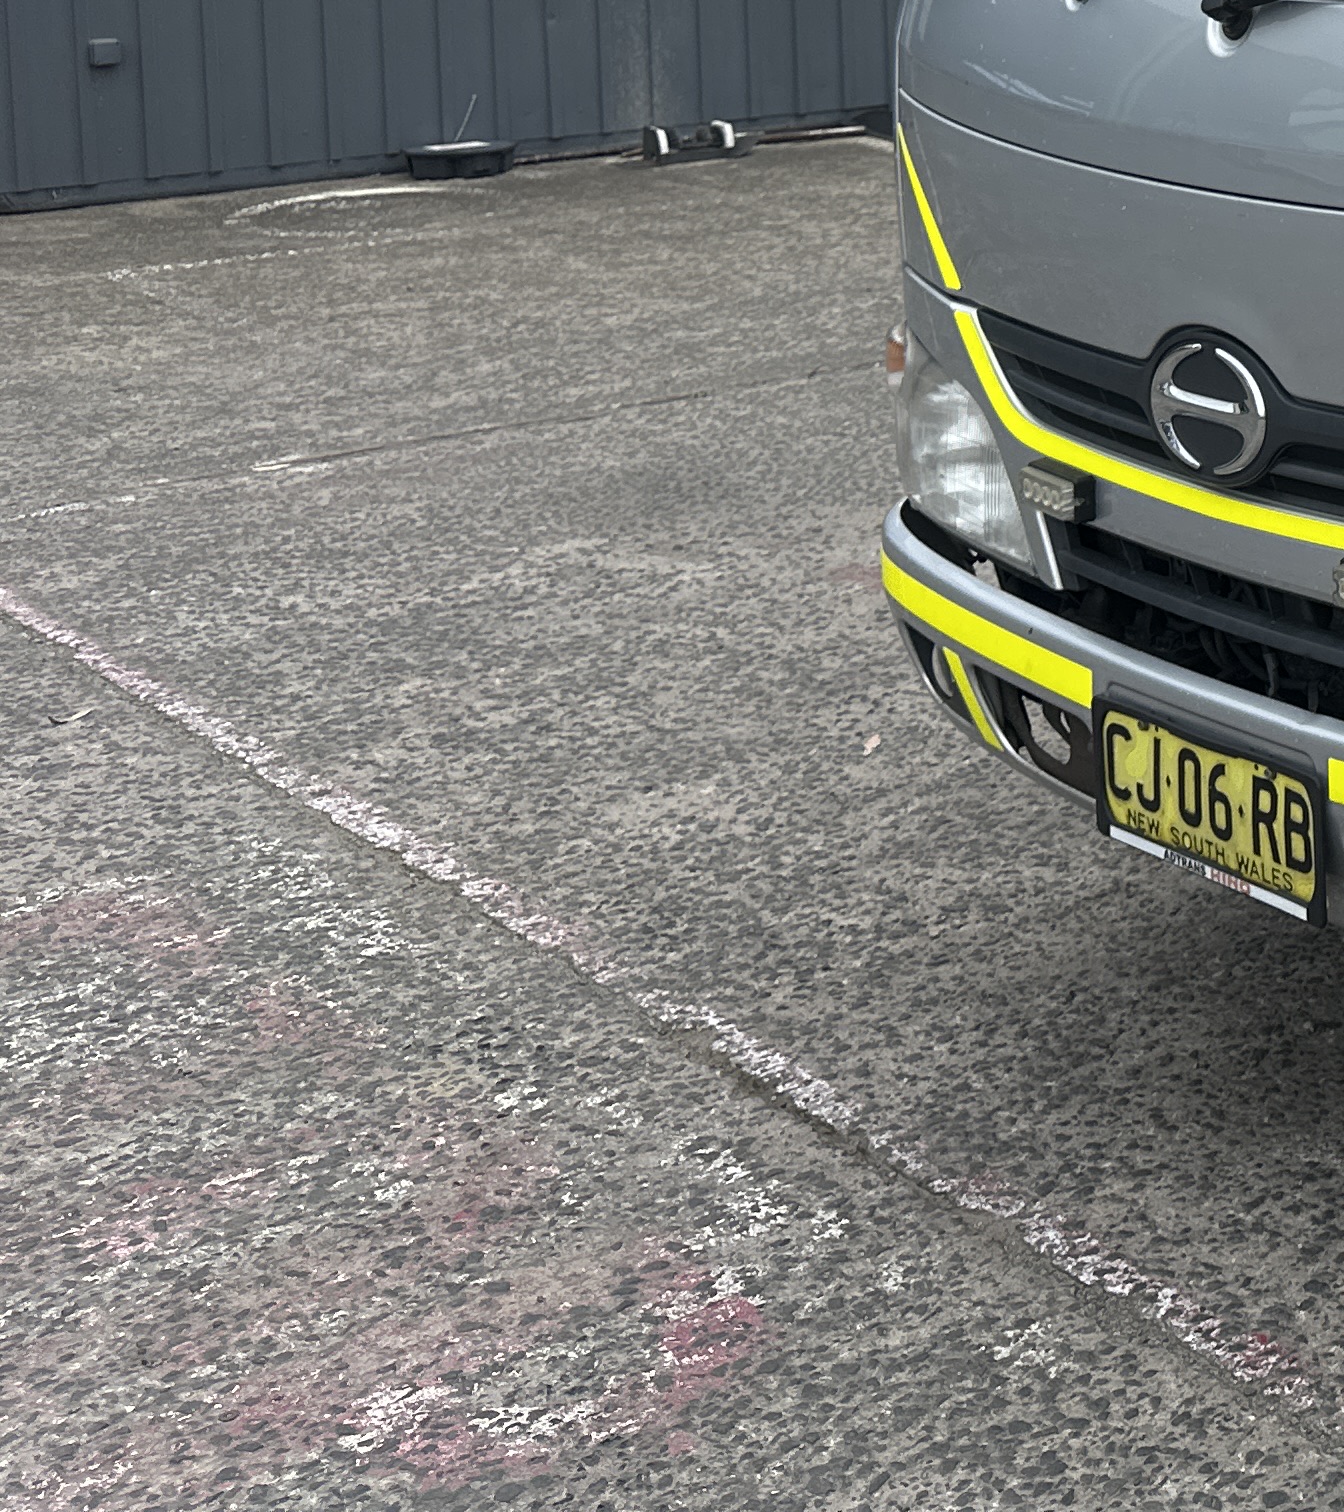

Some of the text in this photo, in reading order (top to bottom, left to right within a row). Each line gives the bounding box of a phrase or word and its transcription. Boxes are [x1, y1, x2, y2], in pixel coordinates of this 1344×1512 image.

[1126, 808, 1294, 892] NEW SOUTH WALES
